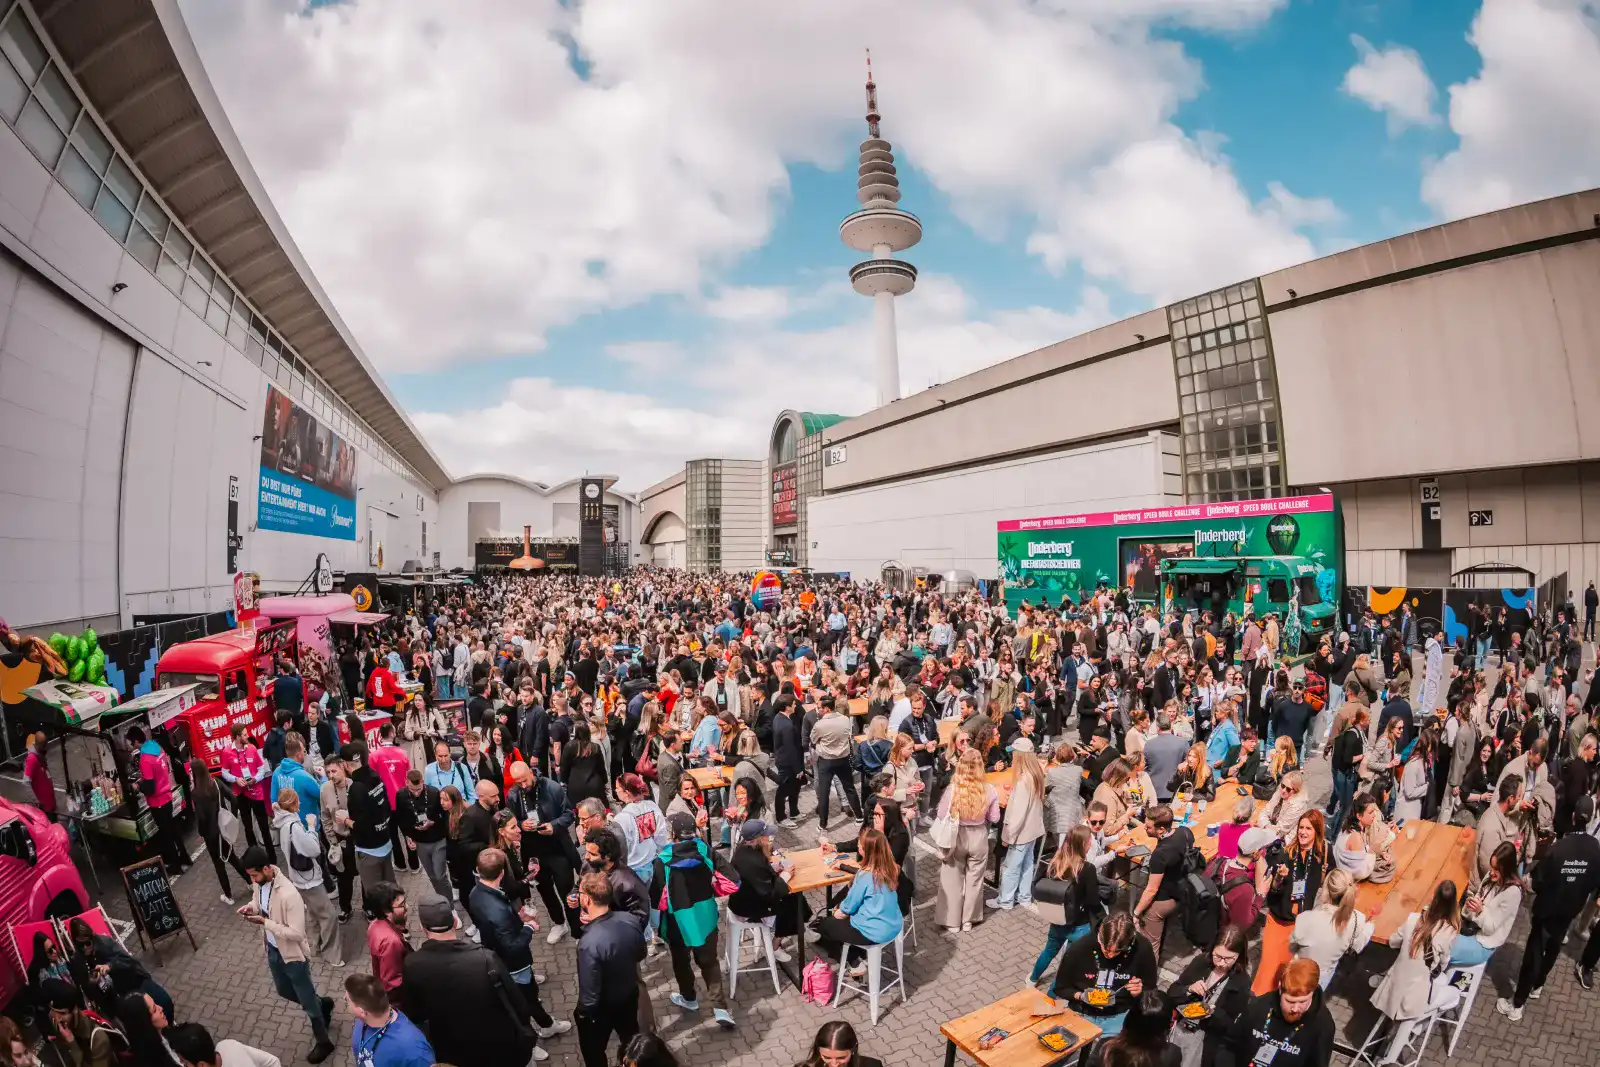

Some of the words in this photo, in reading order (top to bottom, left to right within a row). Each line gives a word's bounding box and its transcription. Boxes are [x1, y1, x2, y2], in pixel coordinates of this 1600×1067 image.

[832, 452, 841, 463] B2
[262, 476, 269, 488] DU
[270, 479, 280, 492] BIST
[281, 482, 290, 496] NUR
[1423, 486, 1438, 500] B2
[261, 491, 297, 510] ENTERTAINMENT
[1206, 504, 1240, 516] Underberg
[1243, 503, 1259, 512] SPEED
[1260, 502, 1277, 511] BOULE
[1278, 500, 1309, 510] CHALLENGE
[1113, 512, 1141, 524] Underberg
[1174, 508, 1200, 517] CHALLENGE
[1473, 516, 1478, 525] P
[1019, 520, 1040, 529] Underberg
[1194, 529, 1245, 545] Underberg
[1028, 541, 1075, 558] Underberg
[227, 699, 248, 715] YUM
[254, 699, 267, 712] YUM
[200, 714, 227, 730] YUM
[251, 722, 266, 737] YUM
[207, 734, 232, 752] YUM
[134, 877, 169, 902] MATCHA
[140, 896, 172, 921] LATTE
